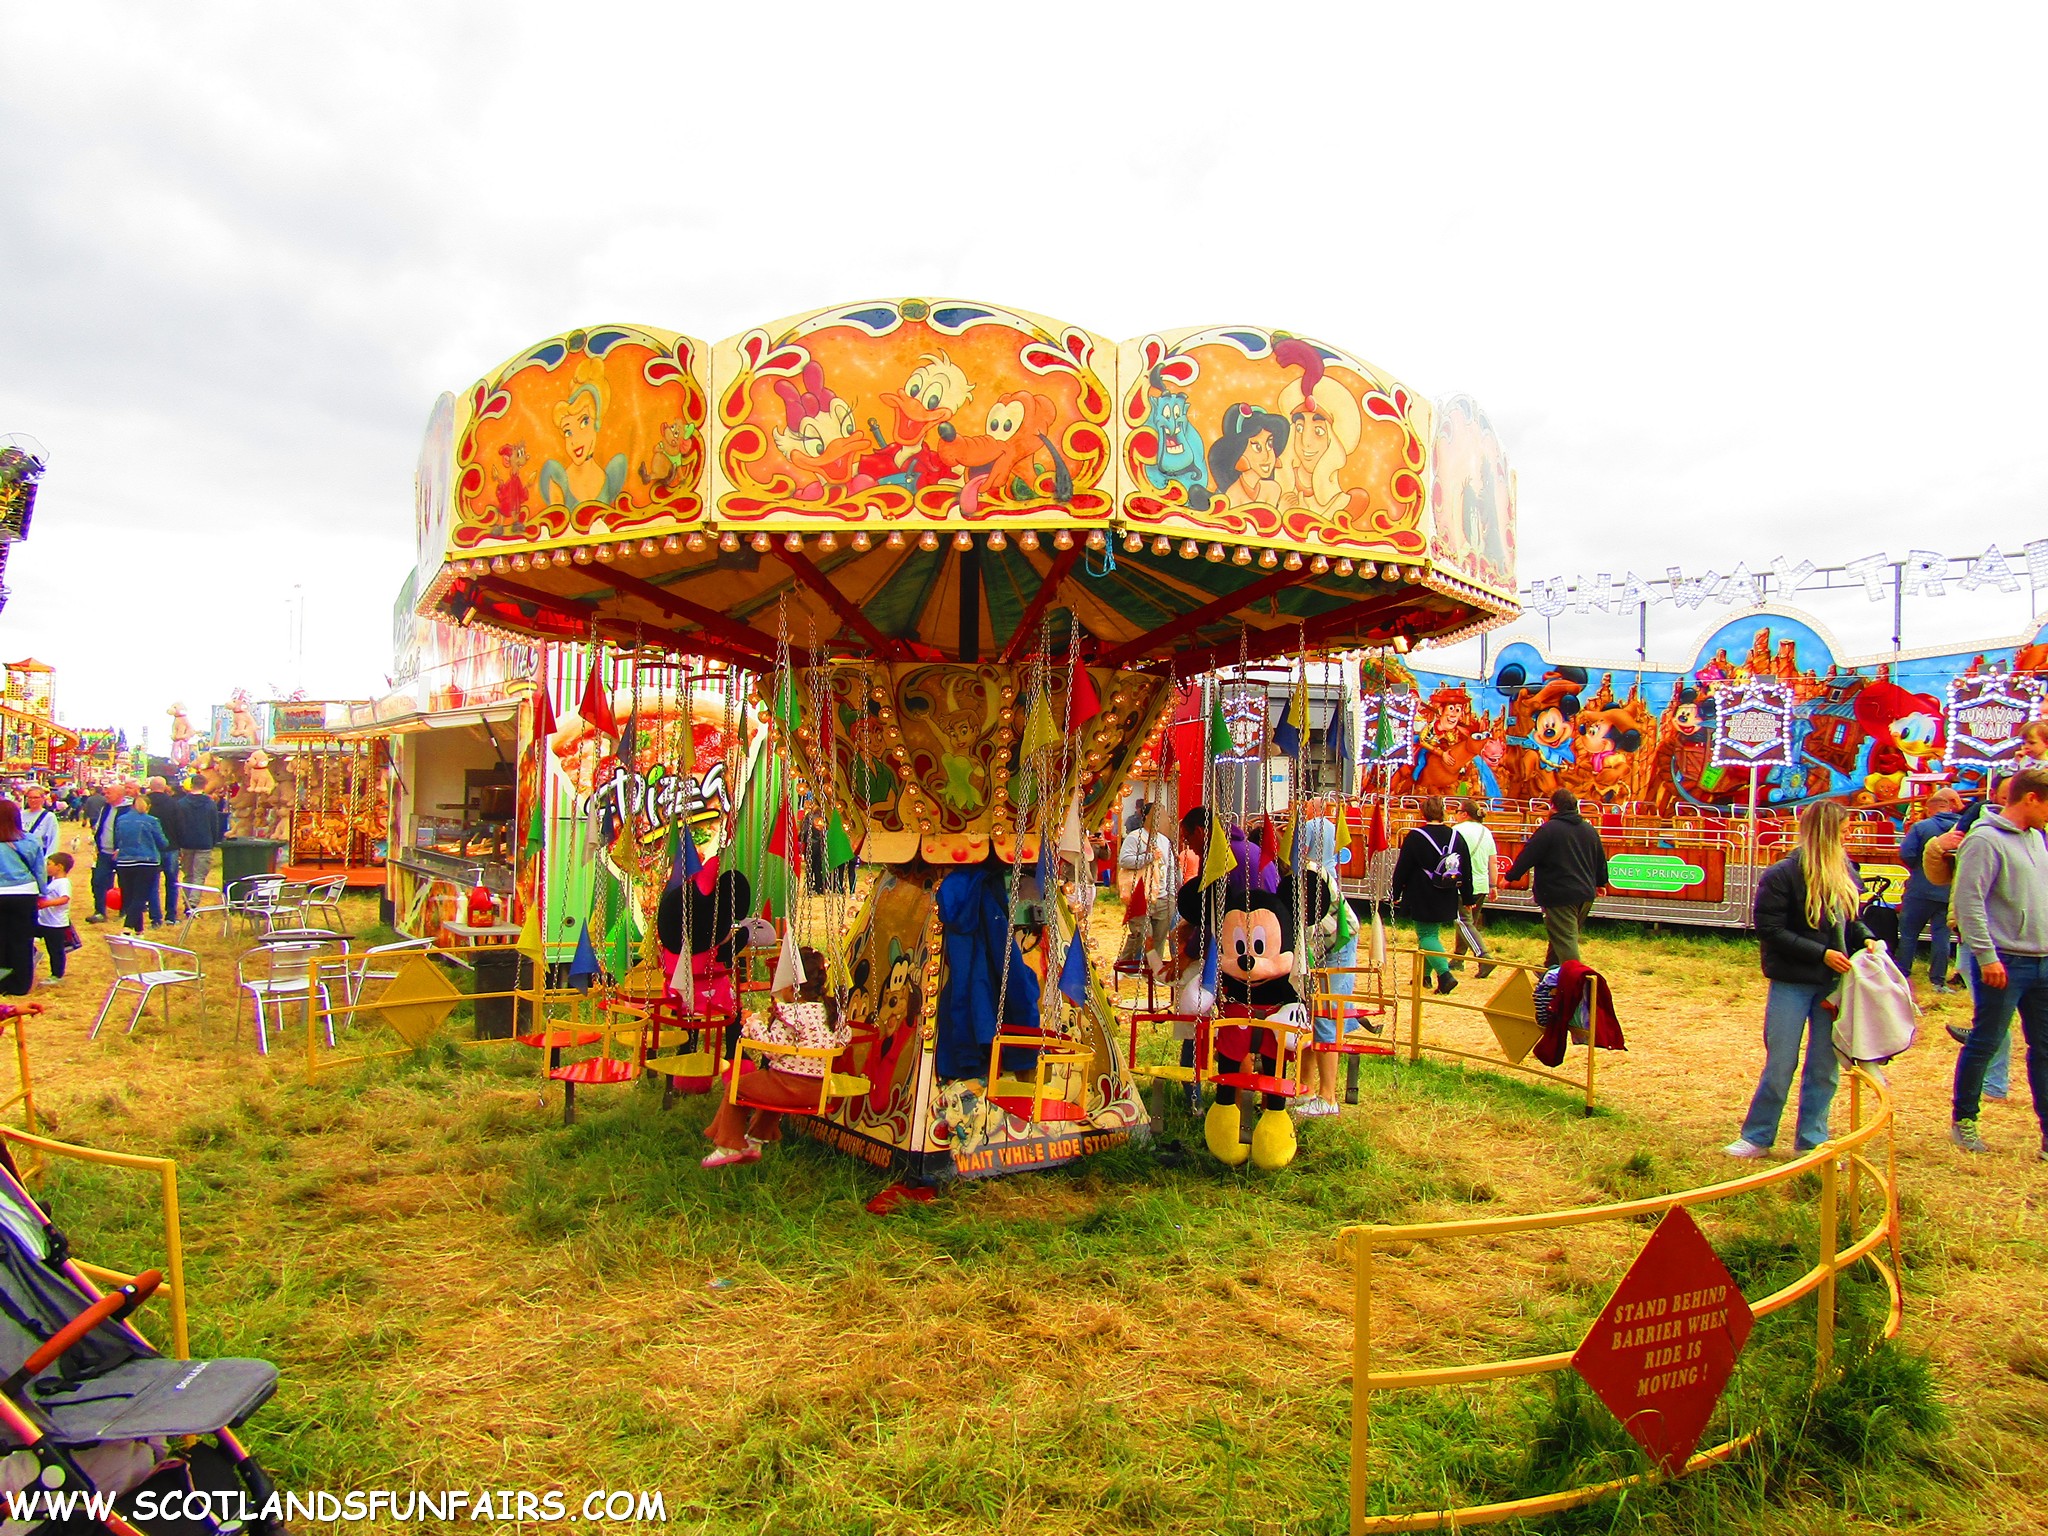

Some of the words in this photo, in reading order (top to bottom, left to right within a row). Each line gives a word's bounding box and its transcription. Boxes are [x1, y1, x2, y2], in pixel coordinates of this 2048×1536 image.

[1957, 706, 2025, 723] RUNAWAY
[1969, 721, 2012, 740] TRAIN
[1608, 866, 1641, 877] ISNEY
[1646, 868, 1696, 880] SPRINGS
[837, 1131, 867, 1158] MOVING
[864, 1142, 893, 1169] CHAIRS
[955, 1149, 994, 1173] WAIT
[998, 1142, 1045, 1168] WHILE
[1048, 1138, 1082, 1161] RIDE
[1613, 1298, 1667, 1324] STAND
[1672, 1285, 1727, 1313] BEHIND
[1611, 1320, 1682, 1350] BARRIER
[1688, 1308, 1729, 1334] WHEN
[1644, 1345, 1682, 1369] RIDE
[1686, 1340, 1703, 1360] IS
[1636, 1366, 1699, 1397] MOVING
